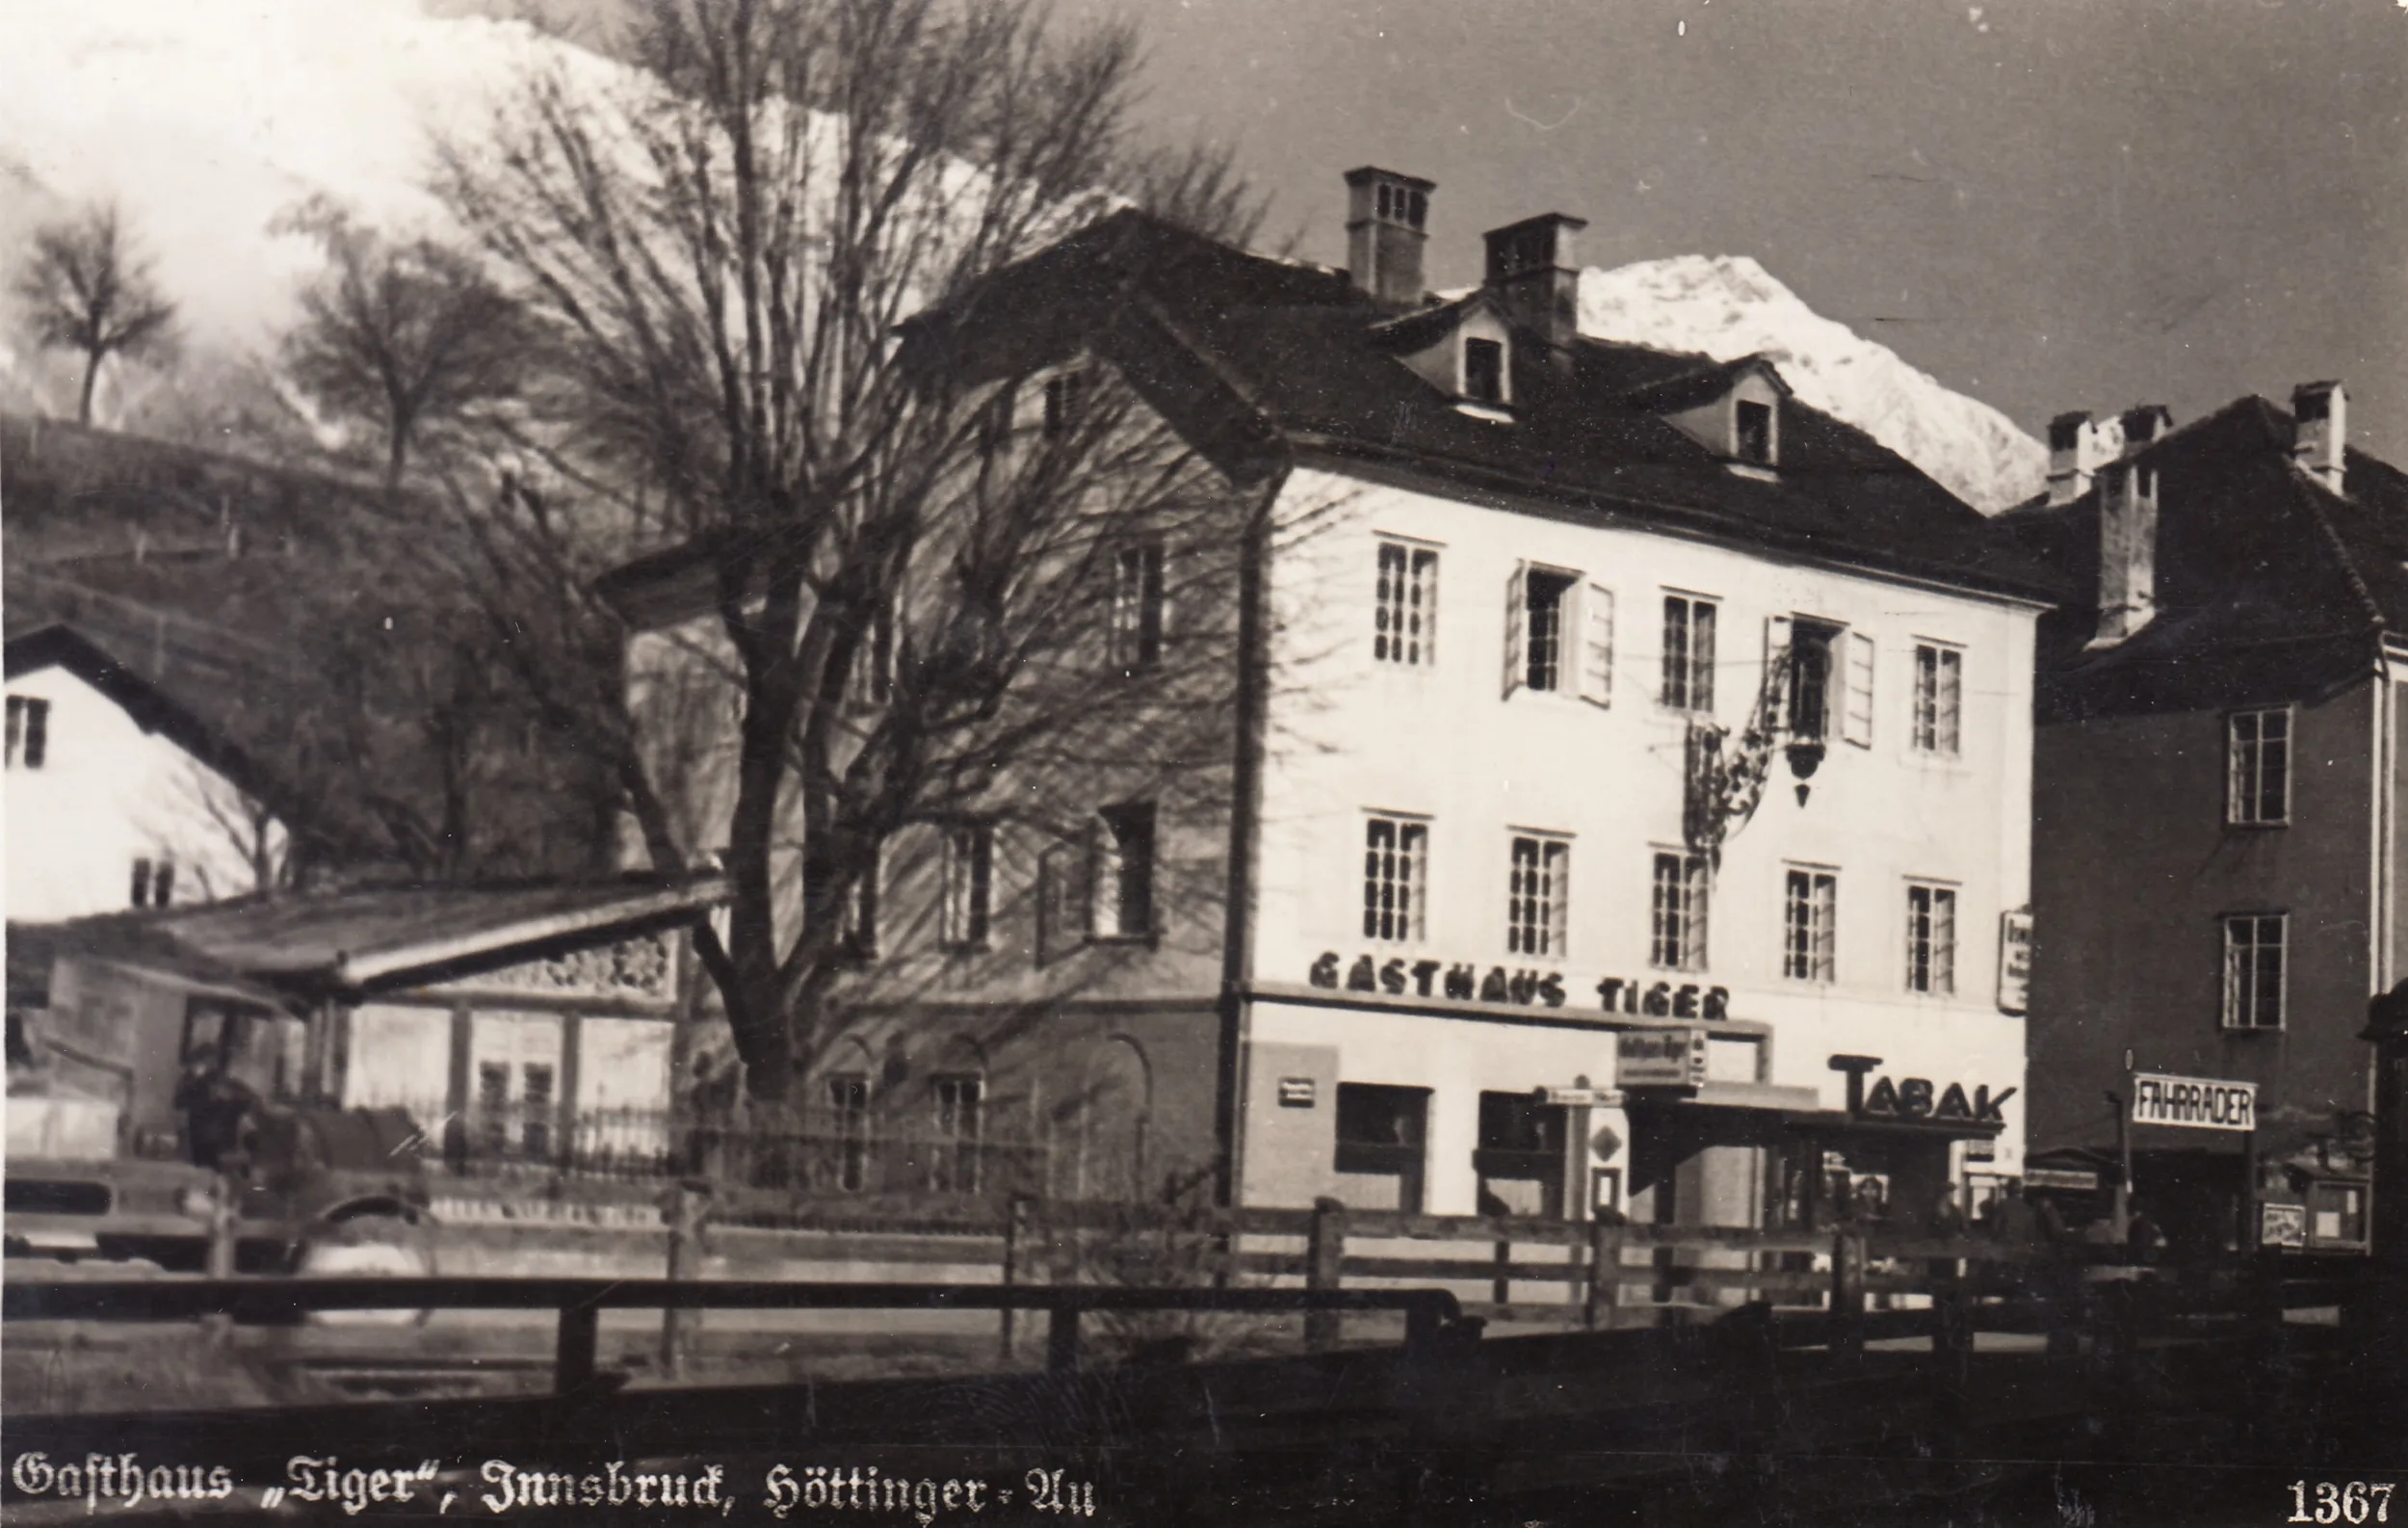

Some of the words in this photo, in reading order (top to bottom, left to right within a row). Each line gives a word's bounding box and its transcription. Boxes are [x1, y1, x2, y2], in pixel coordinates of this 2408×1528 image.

[1309, 951, 1566, 1008] GASTHAUS
[1596, 976, 1729, 1021] TIGER
[1827, 1054, 2017, 1122] TABAK
